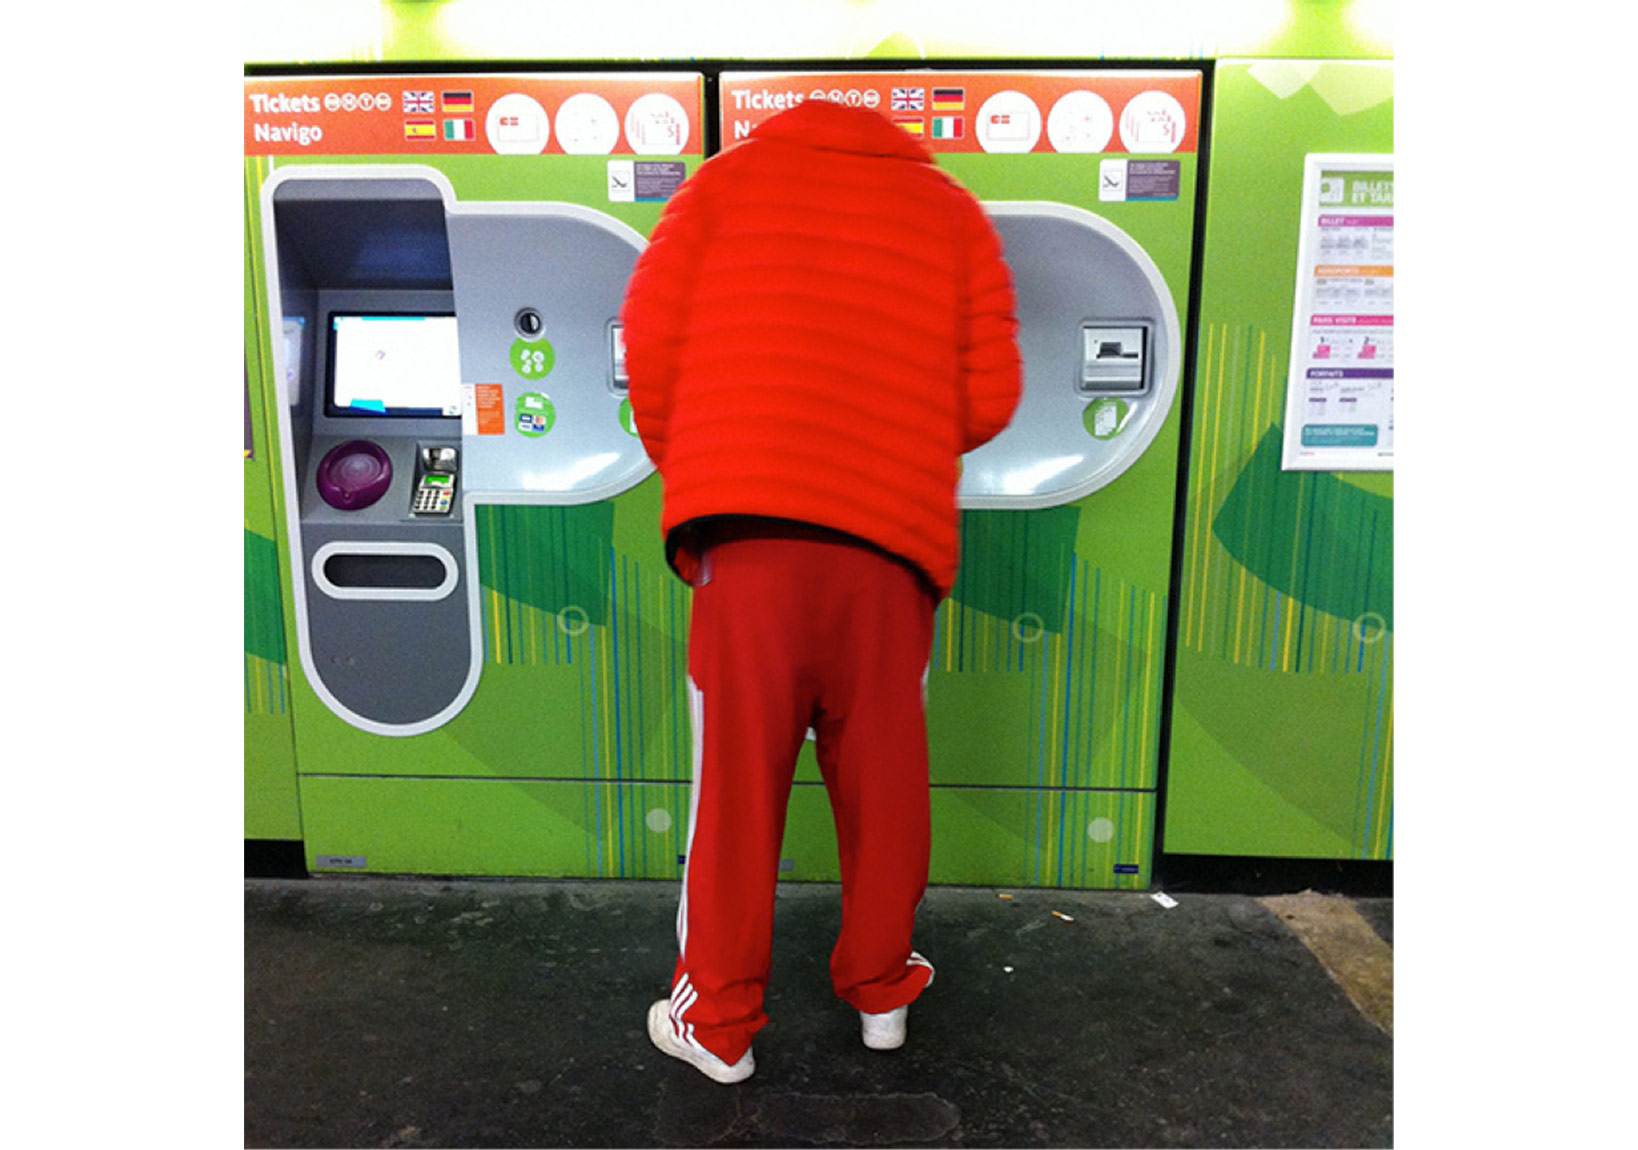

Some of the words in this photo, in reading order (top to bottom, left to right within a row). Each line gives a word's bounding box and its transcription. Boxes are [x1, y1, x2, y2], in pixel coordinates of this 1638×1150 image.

[248, 92, 320, 113] Tickets
[731, 89, 804, 109] Tickets
[254, 121, 322, 146] Navigo
[1321, 217, 1345, 225] BILLET
